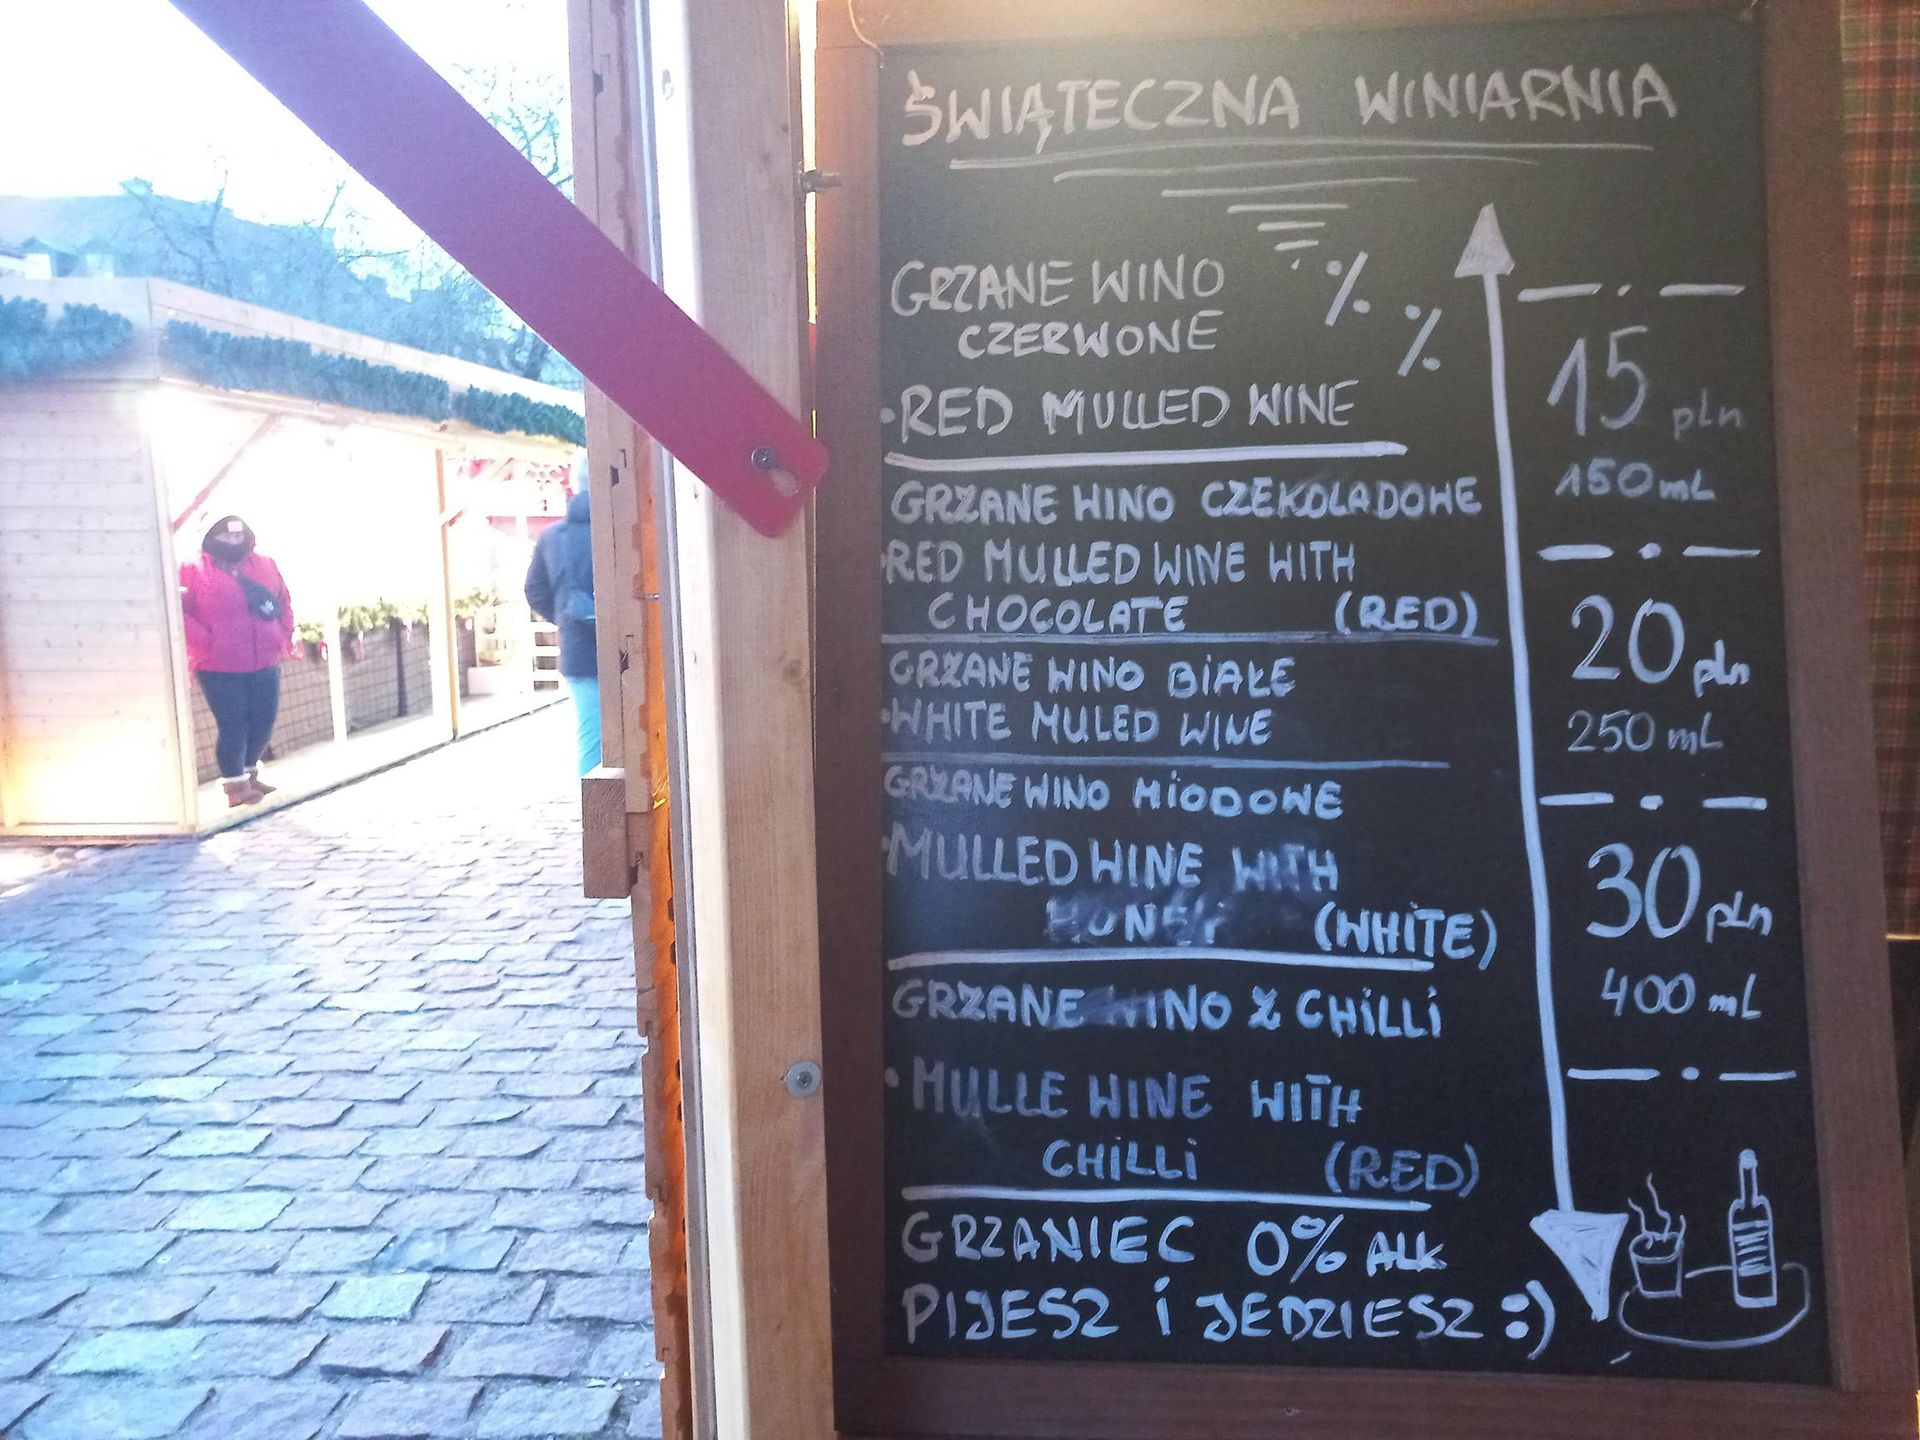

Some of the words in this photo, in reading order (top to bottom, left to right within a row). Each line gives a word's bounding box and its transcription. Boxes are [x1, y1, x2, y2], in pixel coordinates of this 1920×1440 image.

[901, 69, 1300, 154] ŚWIĄTECZNA
[1354, 63, 1677, 124] WINIARNIA
[891, 260, 1073, 316] GRZANE
[1092, 254, 1224, 304] WINO
[958, 310, 1224, 359] CZERWONE
[1547, 326, 1648, 436] 15
[901, 384, 1013, 443] RED
[1042, 386, 1230, 435] MULLED
[1249, 379, 1359, 426] WINE
[891, 481, 1058, 525] GRZANE
[1074, 482, 1176, 522] WINO
[1201, 476, 1481, 519] CZEKOLADOWE
[985, 538, 1140, 587] MULLED
[1154, 540, 1246, 586] WINE
[1269, 541, 1355, 583] WITH
[928, 591, 1188, 633] CHOCOLATE
[1335, 590, 1478, 639] (RED)
[1571, 594, 1685, 683] 20
[889, 649, 1034, 693] GRZANE
[1048, 656, 1145, 694] WINO
[891, 697, 1011, 744] WHITE
[1032, 701, 1159, 745] MULED
[1181, 708, 1272, 751] WINE
[1567, 710, 1655, 752] 250
[884, 765, 1016, 808] GRZANE
[1024, 773, 1110, 810] WINO
[886, 821, 1078, 887] MULLED
[1089, 839, 1202, 888] WINE
[1232, 843, 1338, 892] WITH
[1587, 843, 1700, 938] 30
[892, 978, 1086, 1029] GRZANE
[1602, 967, 1696, 1016] 400
[913, 1056, 1068, 1120] MULLE
[1088, 1071, 1211, 1119] WINE
[1250, 1073, 1361, 1127] WITH
[1325, 1141, 1480, 1197] (RED)
[902, 1211, 1194, 1262] GRZANIEC
[1247, 1214, 1346, 1284] 0%
[1366, 1231, 1447, 1277] ALK
[903, 1284, 1119, 1343] PIJESZ
[1196, 1293, 1484, 1342] JEDZIESZ
